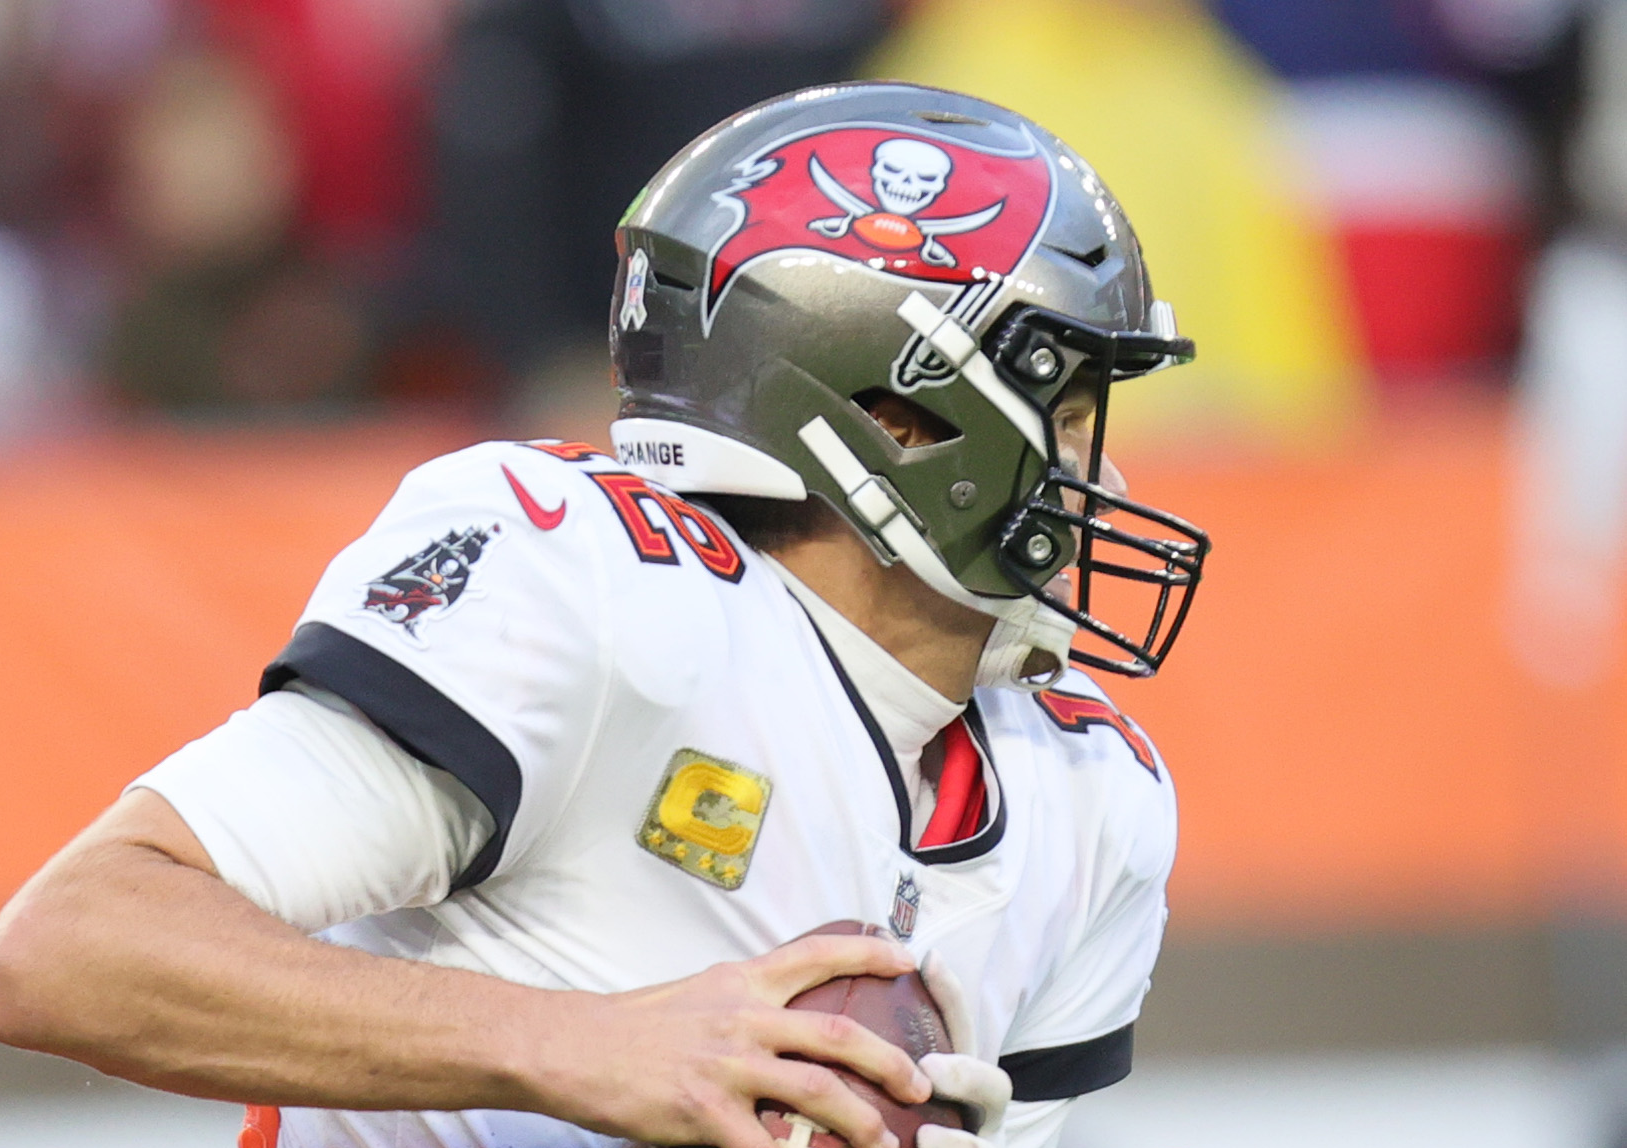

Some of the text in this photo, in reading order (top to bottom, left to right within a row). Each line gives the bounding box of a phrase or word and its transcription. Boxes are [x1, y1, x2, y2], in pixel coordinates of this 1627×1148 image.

[620, 441, 685, 466] CHANGE
[659, 763, 763, 854] C
[894, 896, 917, 932] NFL
